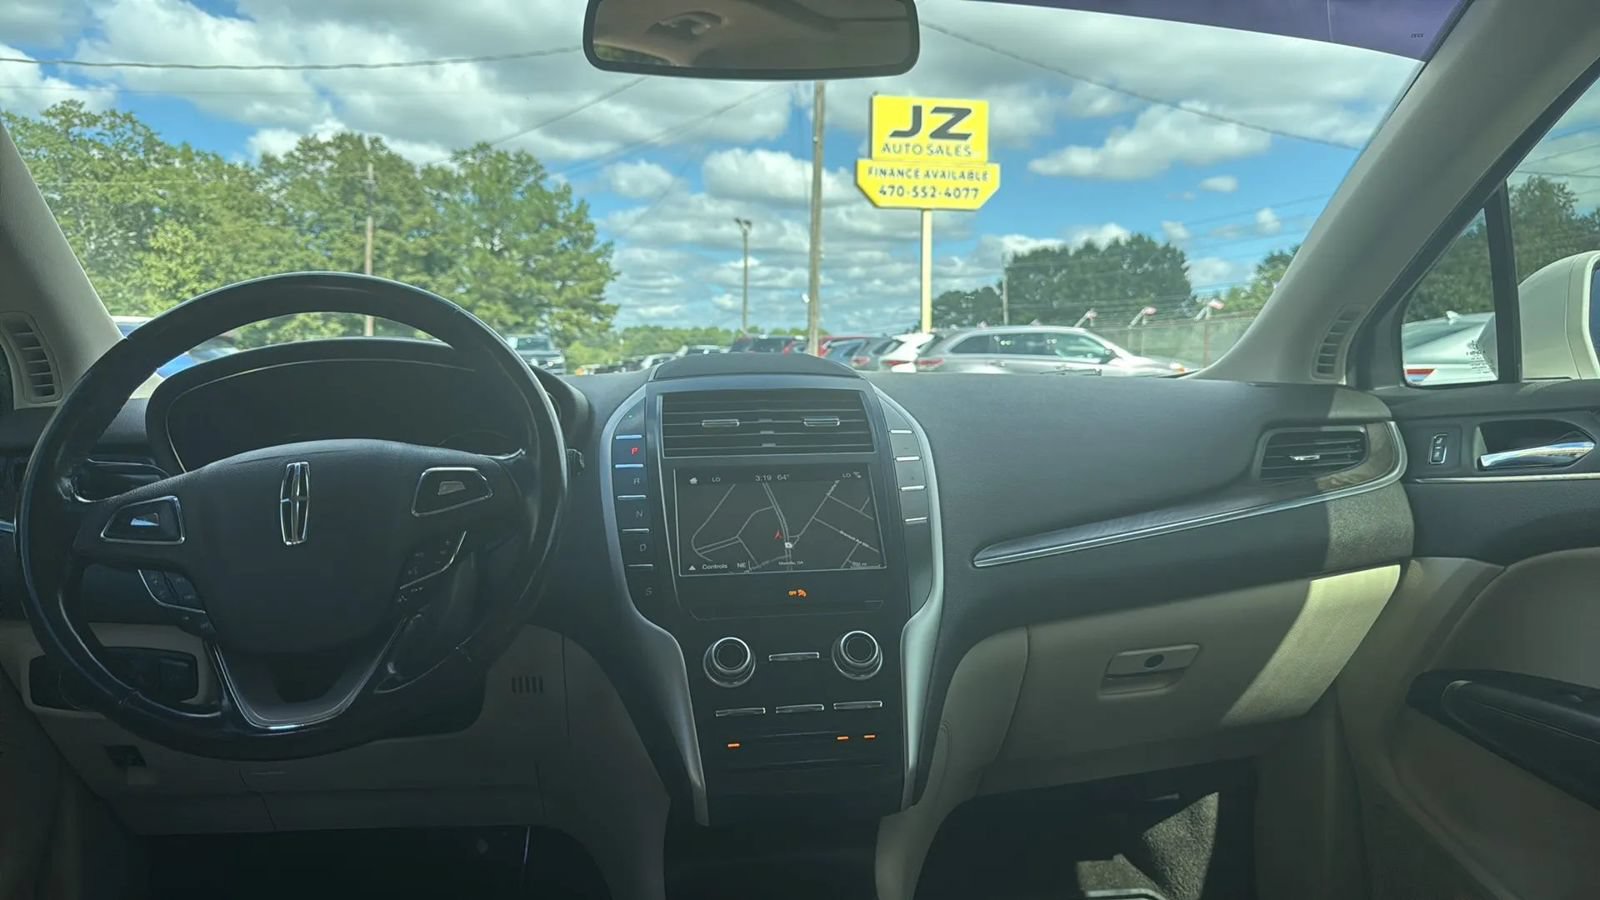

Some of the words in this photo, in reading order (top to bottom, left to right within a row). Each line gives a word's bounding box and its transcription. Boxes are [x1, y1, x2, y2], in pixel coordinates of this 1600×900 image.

[889, 105, 972, 141] JZ
[881, 143, 923, 156] AUTO
[927, 144, 972, 157] SALES
[867, 166, 920, 179] FINANCE
[924, 169, 989, 182] AVAILABLE
[631, 447, 639, 455] P
[636, 510, 643, 518] N
